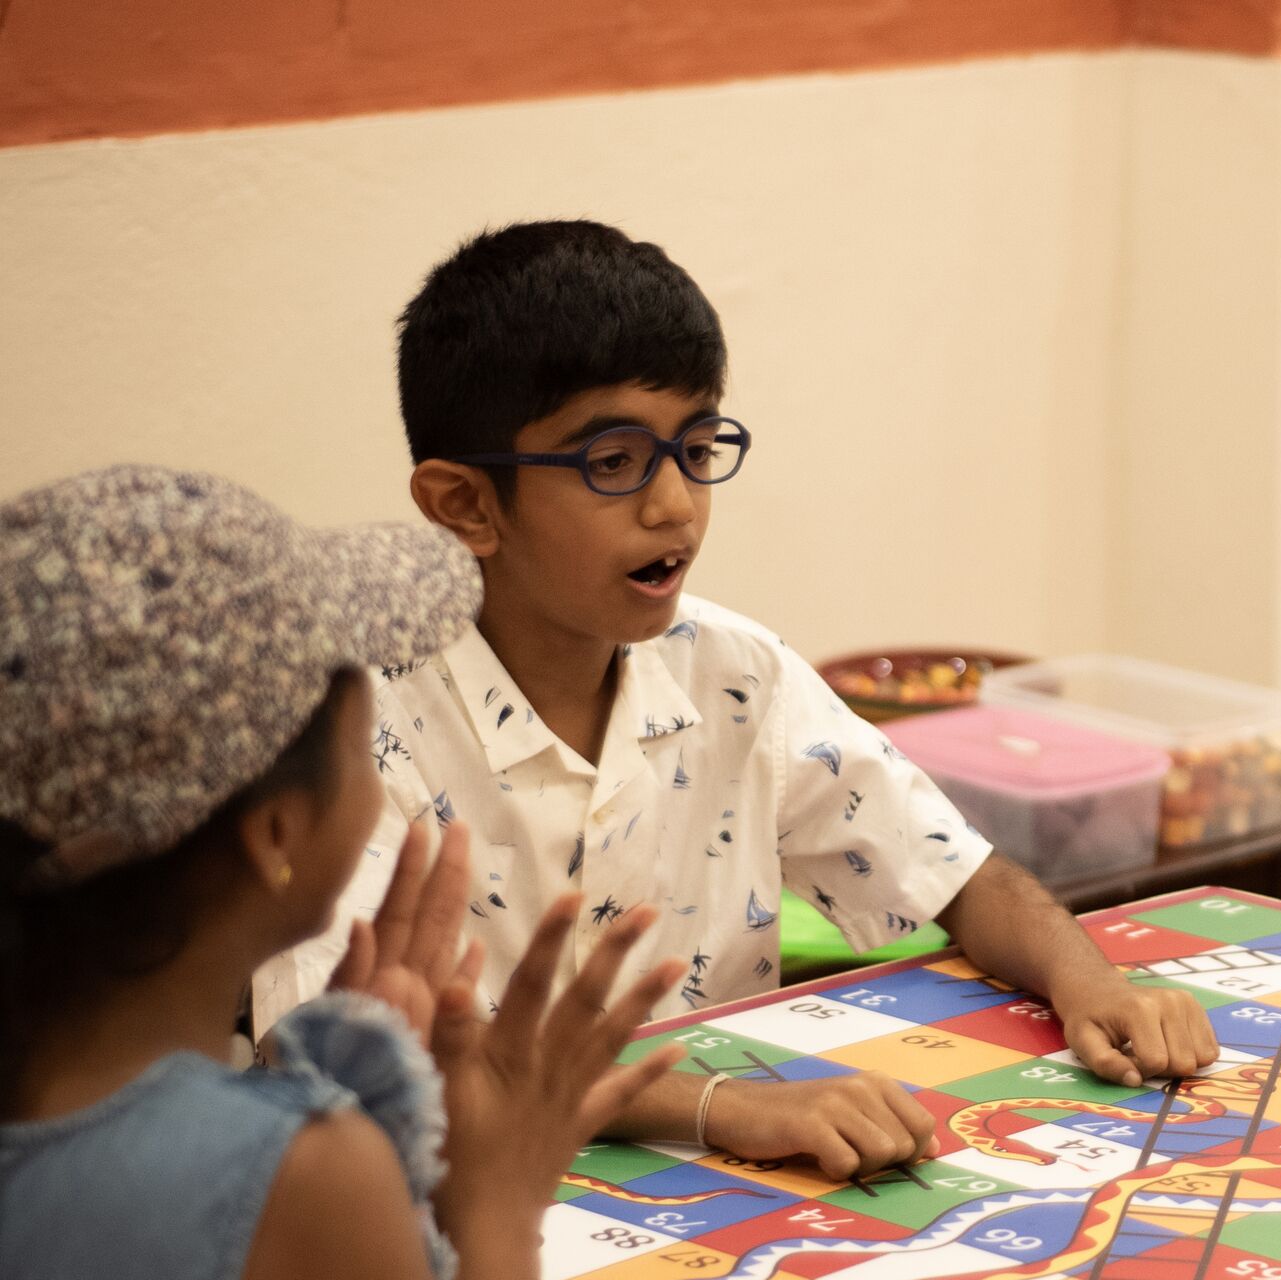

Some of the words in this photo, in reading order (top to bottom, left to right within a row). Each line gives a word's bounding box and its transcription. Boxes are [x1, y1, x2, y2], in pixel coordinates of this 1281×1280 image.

[1200, 899, 1252, 915] 10
[1104, 922, 1156, 938] 11
[1216, 976, 1269, 992] 12
[840, 988, 896, 1007] 31
[789, 1002, 845, 1020] 50
[1008, 1002, 1052, 1020] 32
[674, 1029, 731, 1049] 51
[901, 1034, 956, 1050] 49
[1019, 1066, 1078, 1084] 48
[1072, 1120, 1136, 1138] 47
[1053, 1139, 1117, 1159] 54
[931, 1175, 998, 1192] 67
[644, 1212, 707, 1234] 73
[788, 1208, 854, 1232] 74
[590, 1227, 655, 1249] 88
[973, 1228, 1043, 1251] 66
[658, 1250, 720, 1268] 87
